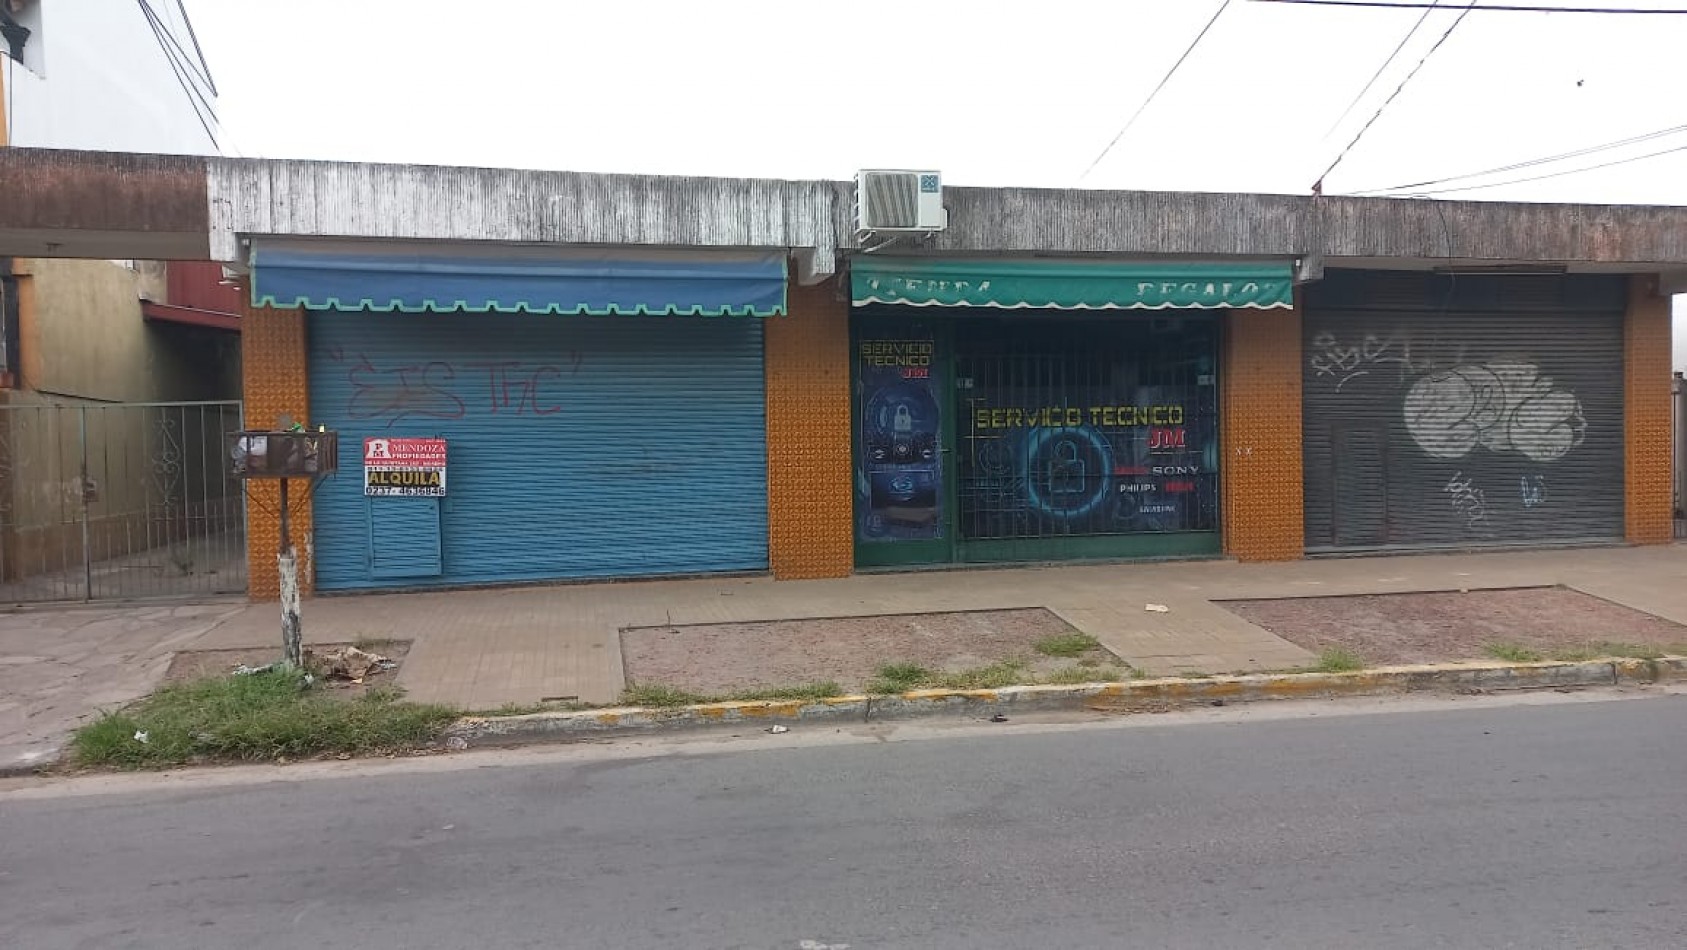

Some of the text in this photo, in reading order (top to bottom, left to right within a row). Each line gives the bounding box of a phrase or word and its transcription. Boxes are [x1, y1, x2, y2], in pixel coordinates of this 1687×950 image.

[863, 342, 933, 355] SERVICIO
[863, 355, 930, 367] TECNICO
[1148, 428, 1186, 448] JM
[392, 444, 446, 452] MENDOZA
[1152, 466, 1199, 475] SONY
[368, 471, 440, 486] ALQUILA
[1120, 483, 1157, 493] PHILIPS
